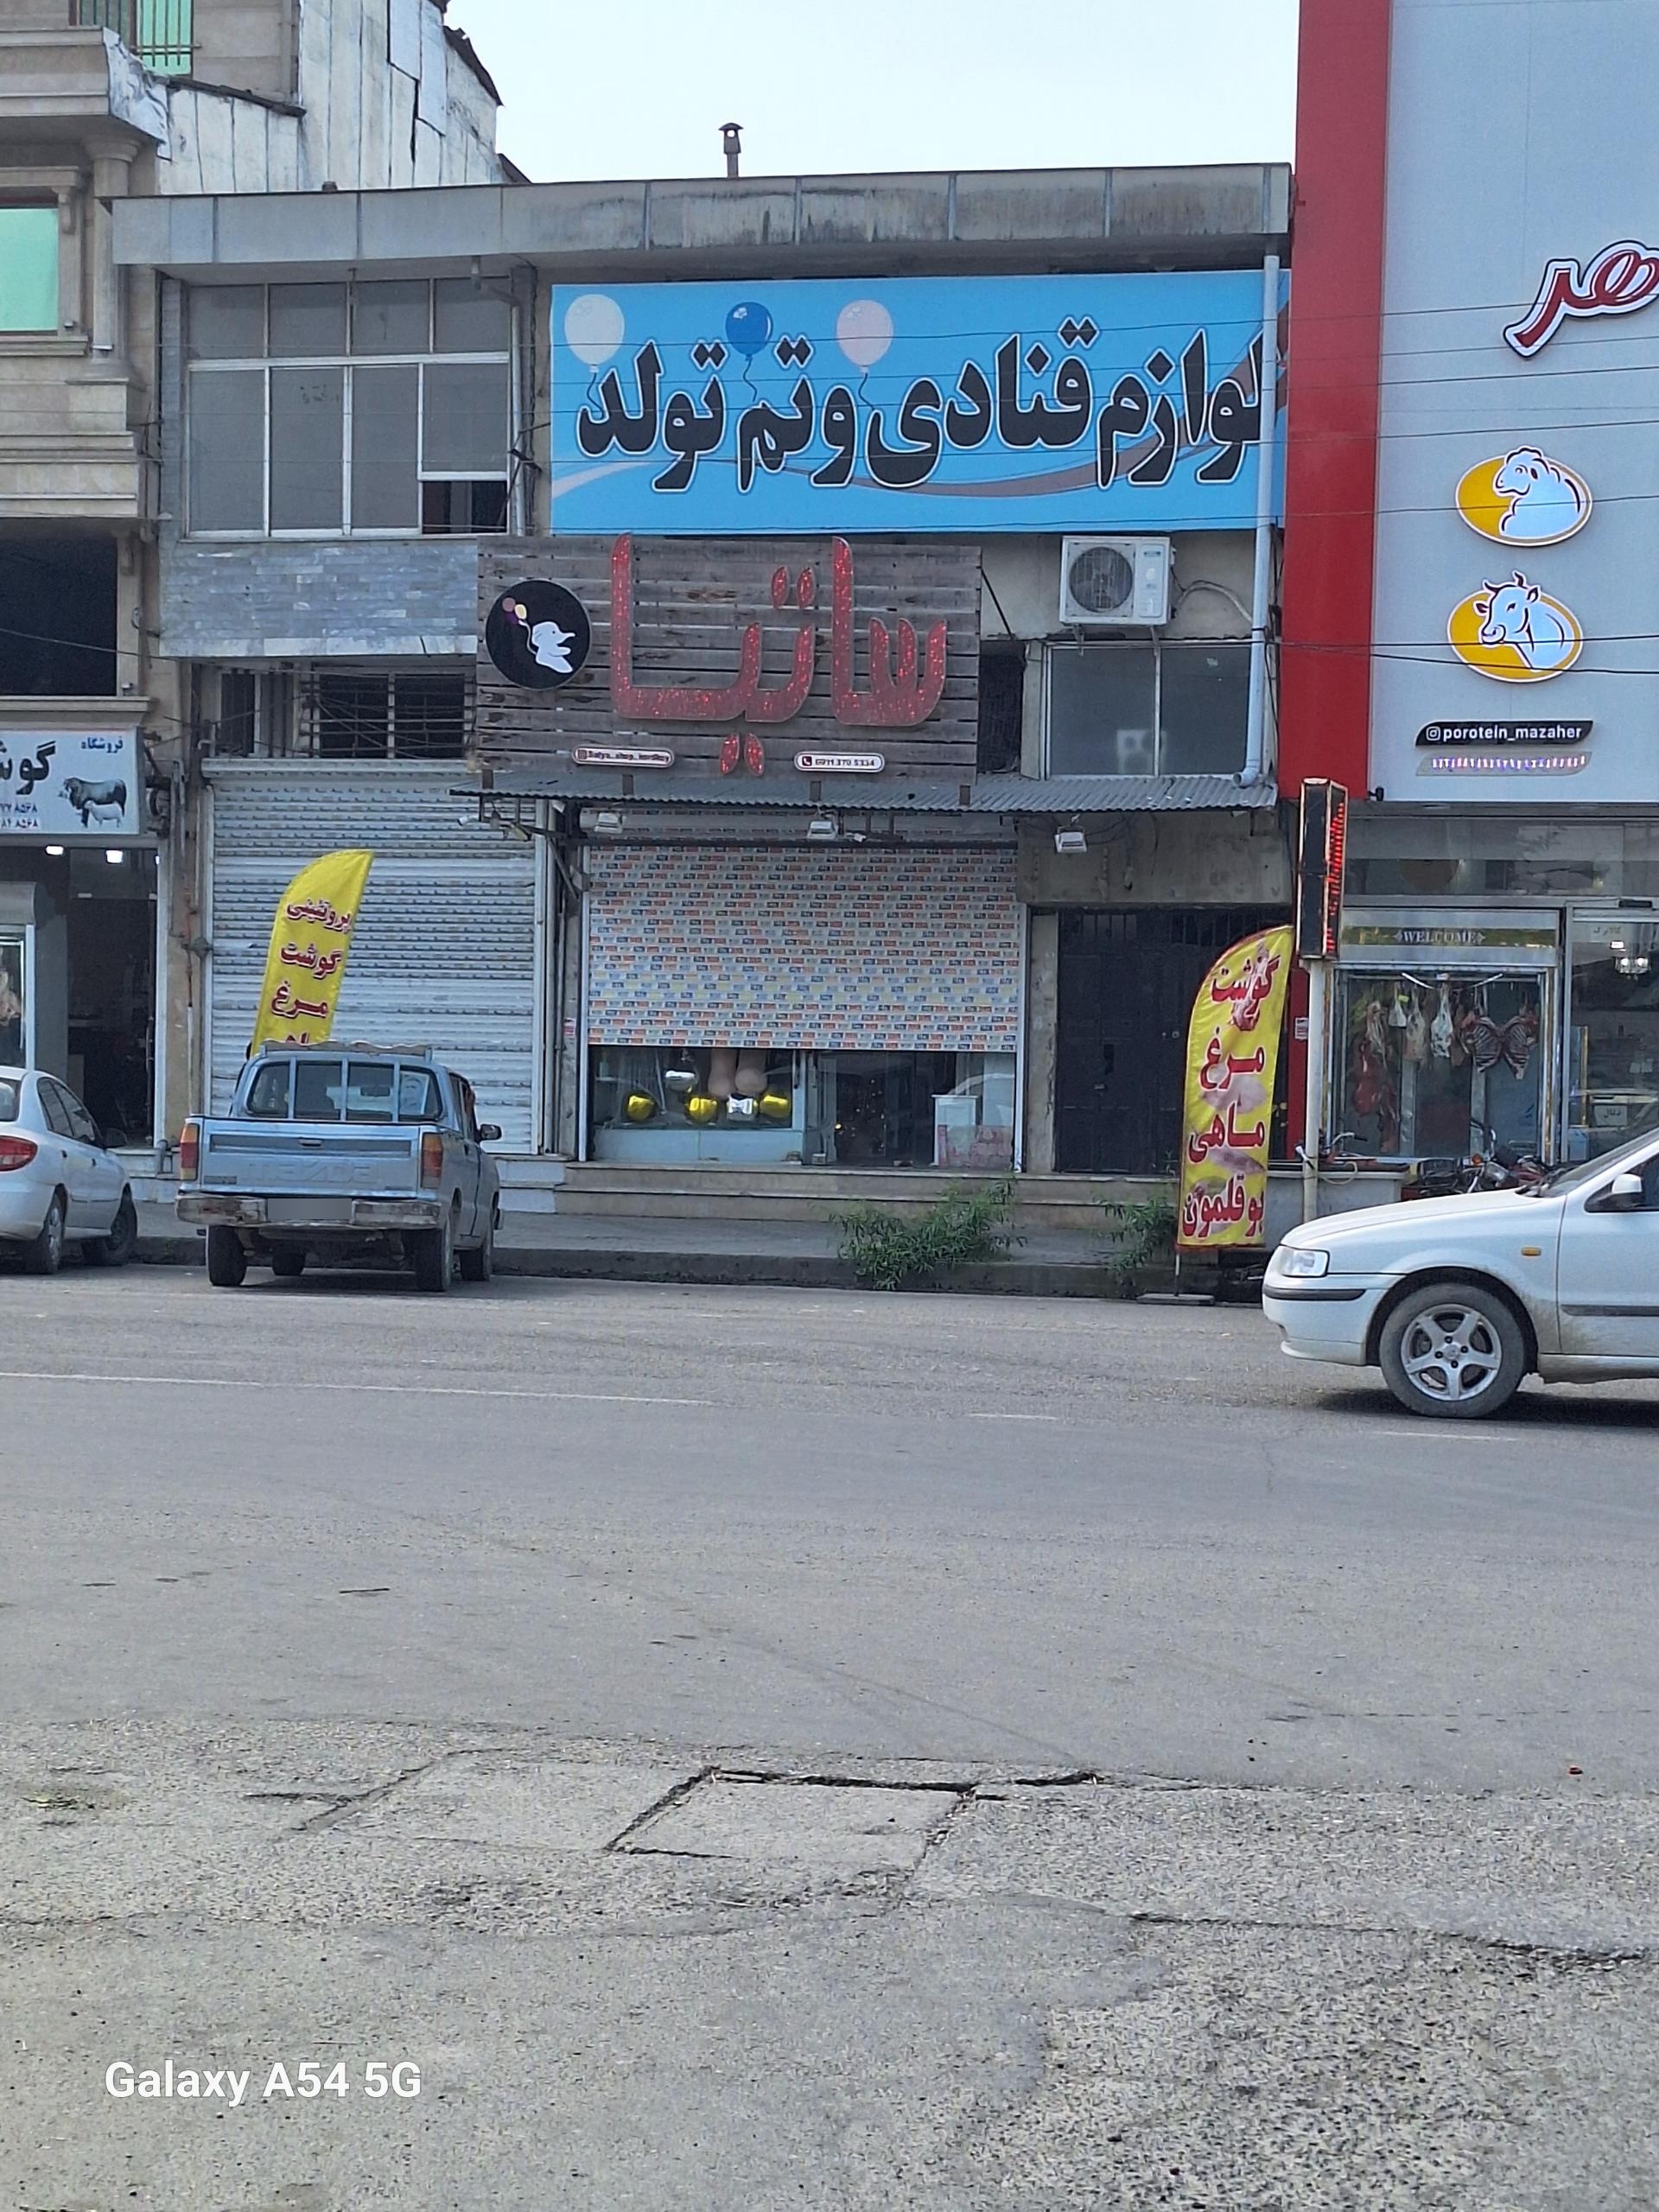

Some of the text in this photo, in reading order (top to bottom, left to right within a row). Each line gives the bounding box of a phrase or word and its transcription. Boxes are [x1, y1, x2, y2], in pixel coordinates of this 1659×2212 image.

[577, 339, 728, 493] تولد
[865, 316, 1099, 487] قنادی
[81, 735, 124, 753] فروشگاه
[280, 942, 343, 979] گوشت
[1403, 930, 1478, 944] WELCOME
[271, 980, 329, 1019] مرغ
[1211, 954, 1281, 1017] گوشت
[1198, 1026, 1266, 1091] مرغ
[1187, 1100, 1265, 1165] ماهی
